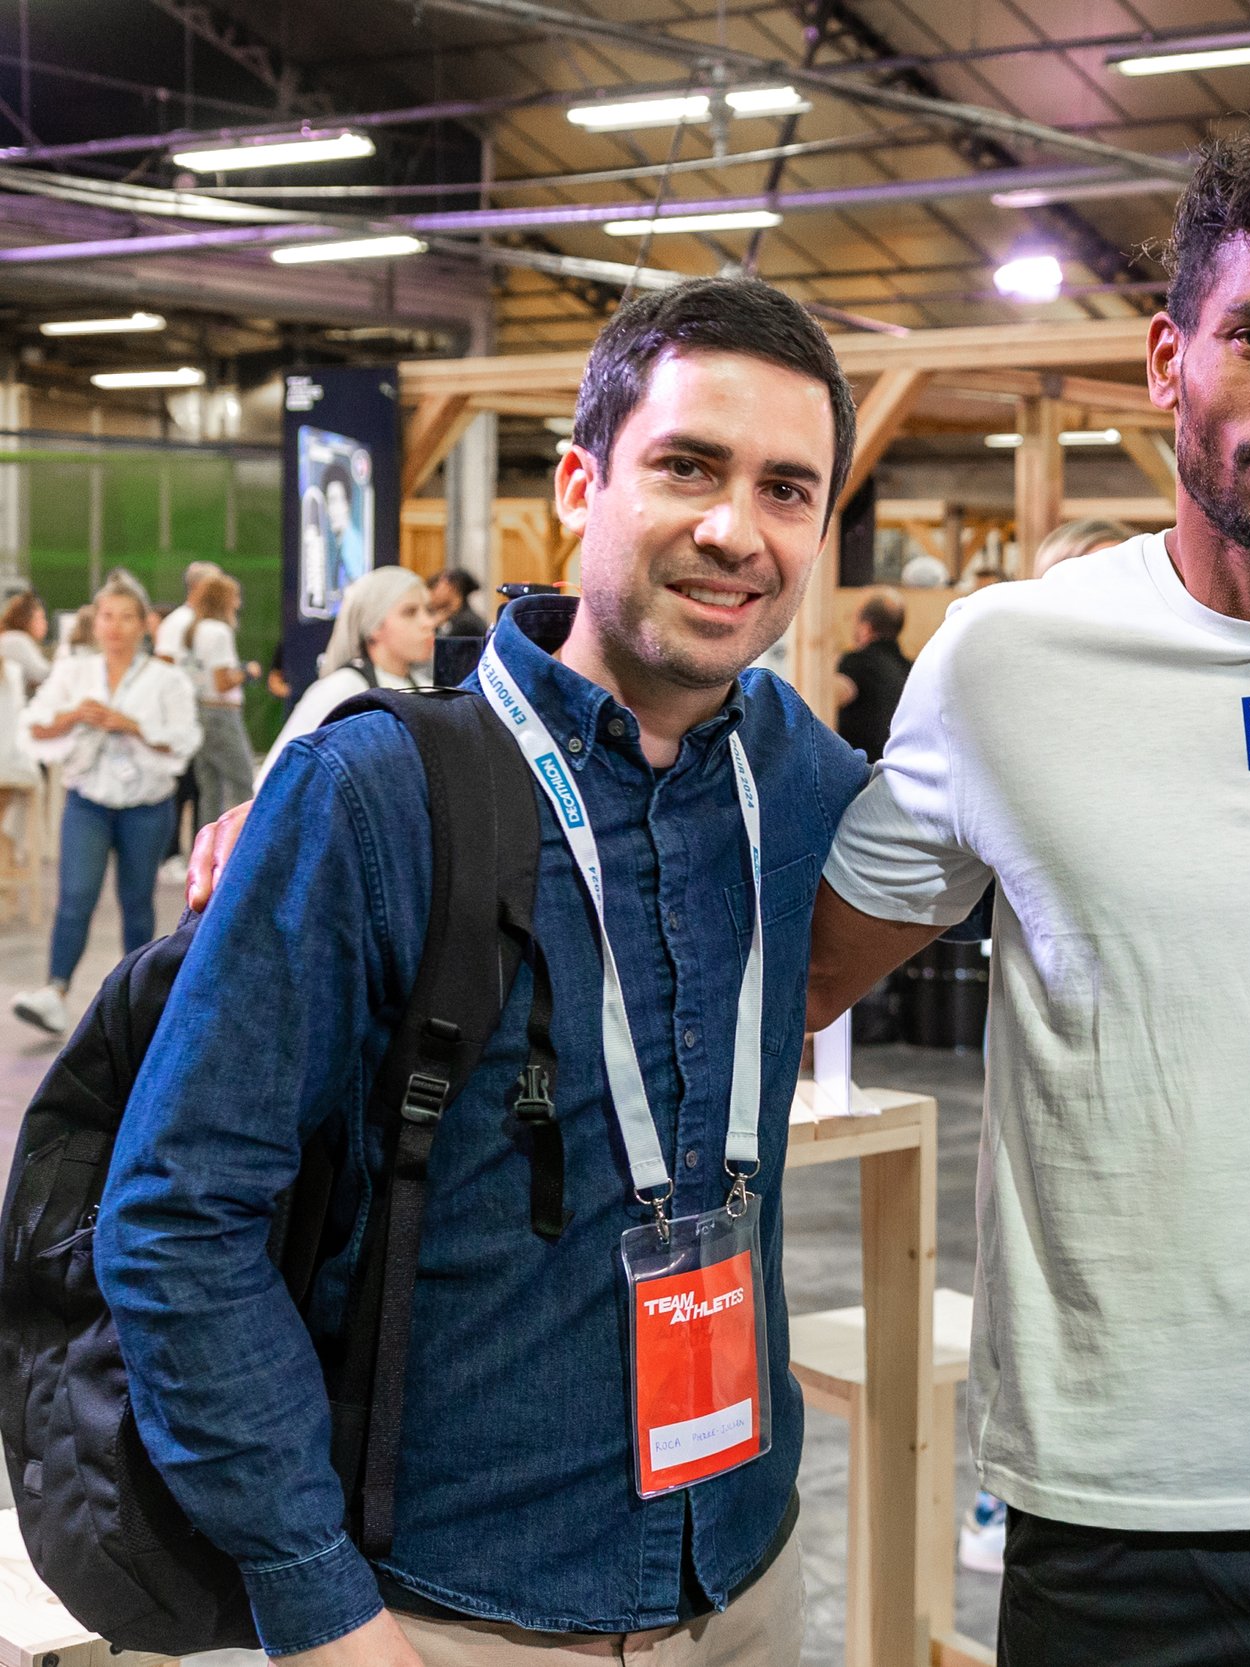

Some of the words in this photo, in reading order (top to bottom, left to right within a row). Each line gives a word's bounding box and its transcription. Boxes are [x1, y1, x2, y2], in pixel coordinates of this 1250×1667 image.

[485, 667, 515, 708] ROUTE
[508, 706, 527, 725] EN
[540, 758, 580, 823] DECATHLON
[740, 776, 755, 809] 2024
[643, 1290, 695, 1316] TEAM
[669, 1287, 744, 1325] ATHLETES
[655, 1437, 681, 1453] ROCA
